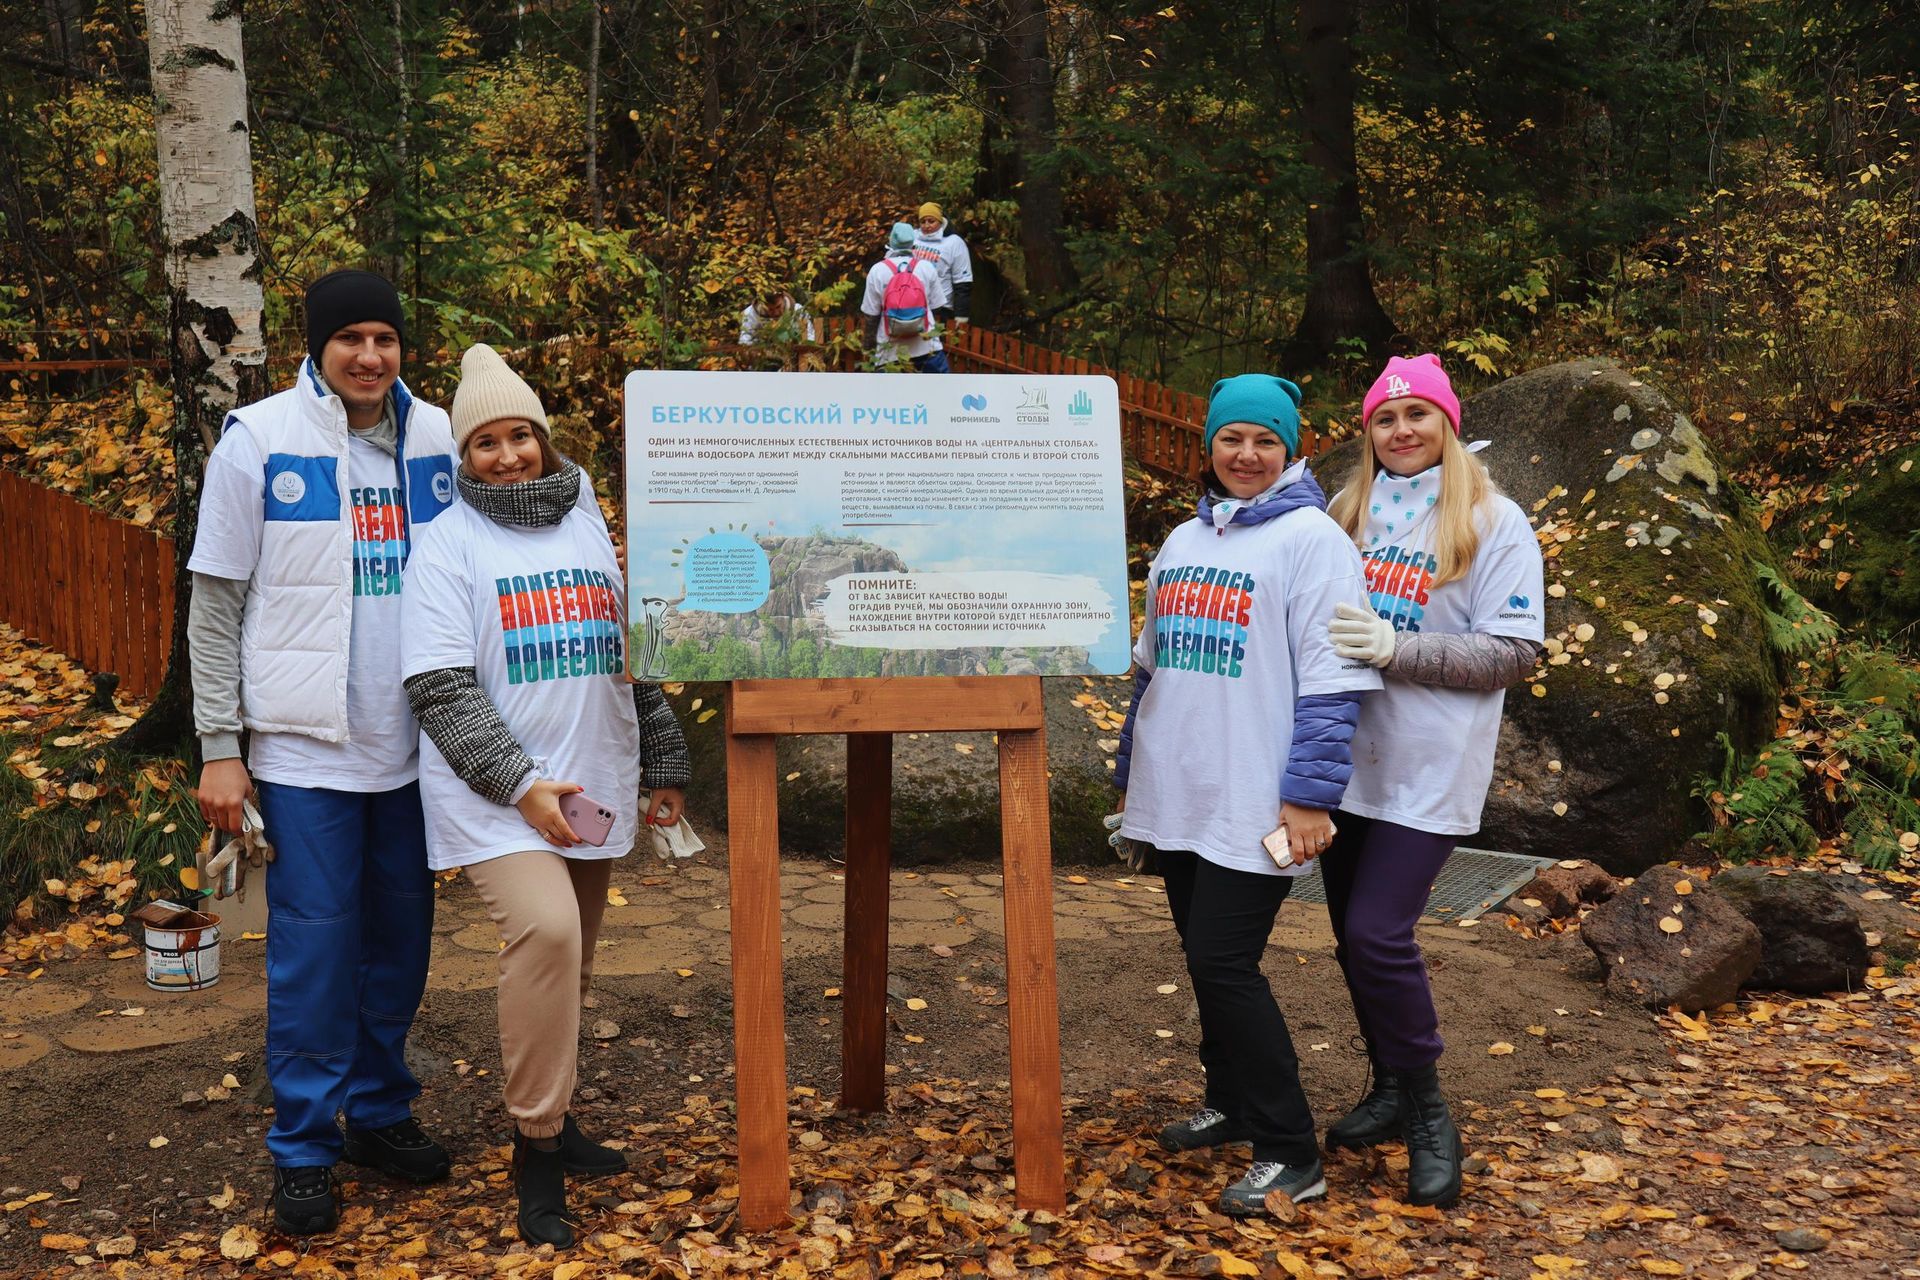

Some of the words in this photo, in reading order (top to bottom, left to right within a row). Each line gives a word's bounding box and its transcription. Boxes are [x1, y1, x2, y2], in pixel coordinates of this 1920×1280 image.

[1386, 375, 1411, 399] LA
[651, 404, 841, 424] БЕРКУТОВСКИЙ
[853, 403, 928, 424] РУЧЕЙ
[648, 438, 675, 446] ОДИН
[678, 438, 691, 446] ИЗ
[694, 438, 795, 446] НЕМНОГОЧИСЛЕННЫХ
[799, 439, 869, 447] ЕСТЕСТВЕННЫХ
[872, 439, 933, 447] ИСТОЧНИКОВ
[935, 439, 962, 447] ВОДЫ
[965, 439, 978, 447] НА
[648, 451, 695, 459] ВЕРШИНА
[697, 451, 755, 459] ВОДОСБОРА
[758, 451, 790, 459] ЛЕЖИТ
[793, 451, 826, 459] МЕЖДУ
[829, 451, 888, 459] СКАЛЬНЫМИ
[1023, 452, 1030, 460] И
[1032, 452, 1068, 460] ВТОРОЙ
[1071, 452, 1100, 460] СТОЛБ
[848, 580, 917, 590] ПОМНИТЕ:
[894, 603, 926, 611] РУЧЕЙ,
[928, 603, 944, 611] МЫ
[947, 603, 1008, 611] ОБОЗНАЧИЛИ
[1065, 602, 1091, 610] ЗОНУ,
[916, 613, 951, 621] ВНУТРИ
[998, 612, 1026, 620] БУДЕТ
[1029, 612, 1111, 620] НЕБЛАГОПРИЯТНО
